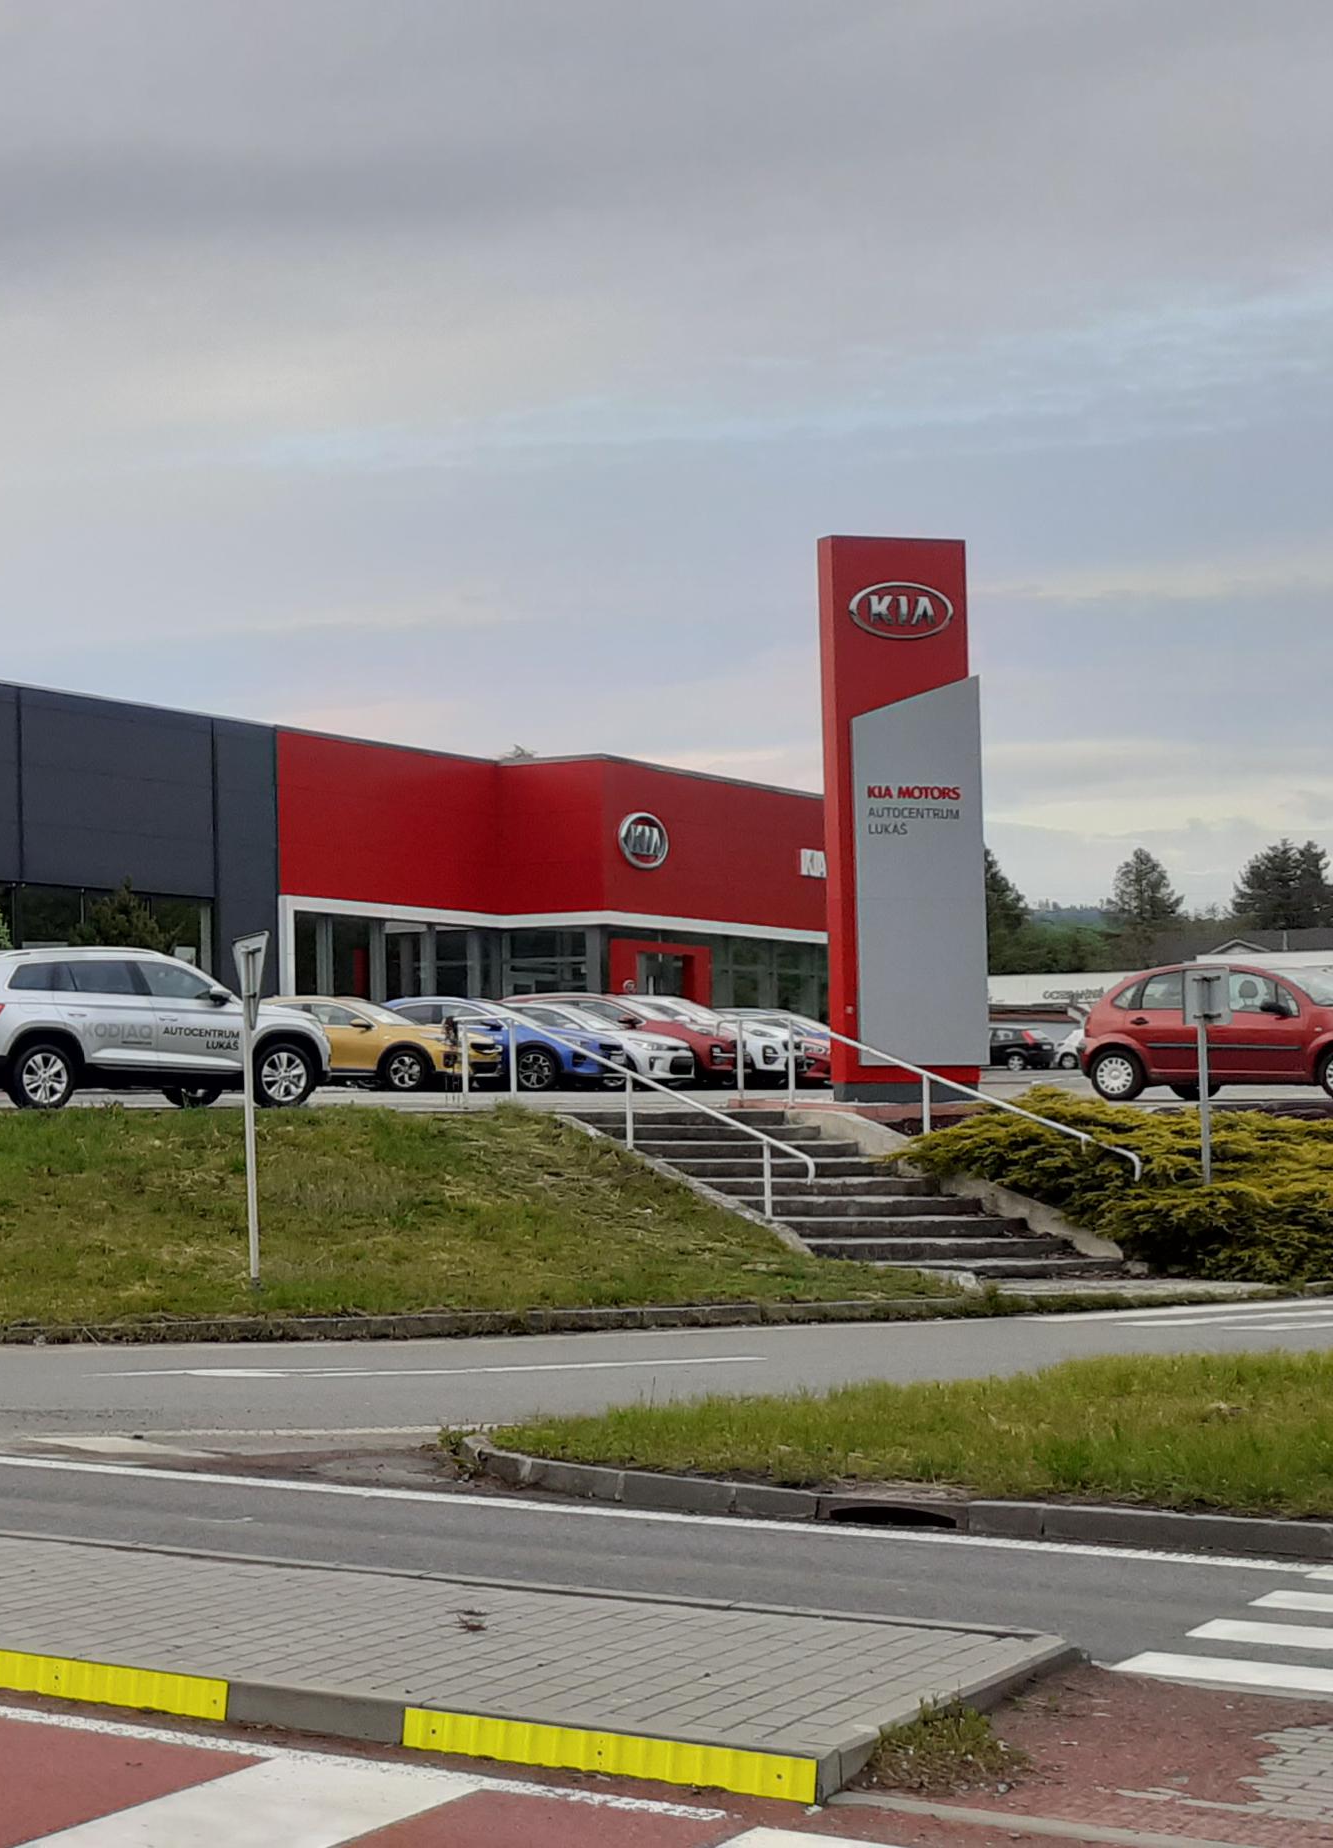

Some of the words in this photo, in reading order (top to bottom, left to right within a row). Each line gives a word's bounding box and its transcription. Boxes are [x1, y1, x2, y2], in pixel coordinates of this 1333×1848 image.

[869, 595, 935, 625] KIA
[868, 786, 893, 799] KIA
[897, 786, 961, 800] MOTORS
[868, 807, 960, 819] AUTOCENTRUM
[83, 1022, 153, 1040] KODIAQ
[162, 1026, 240, 1039] AUTOCENTRUM
